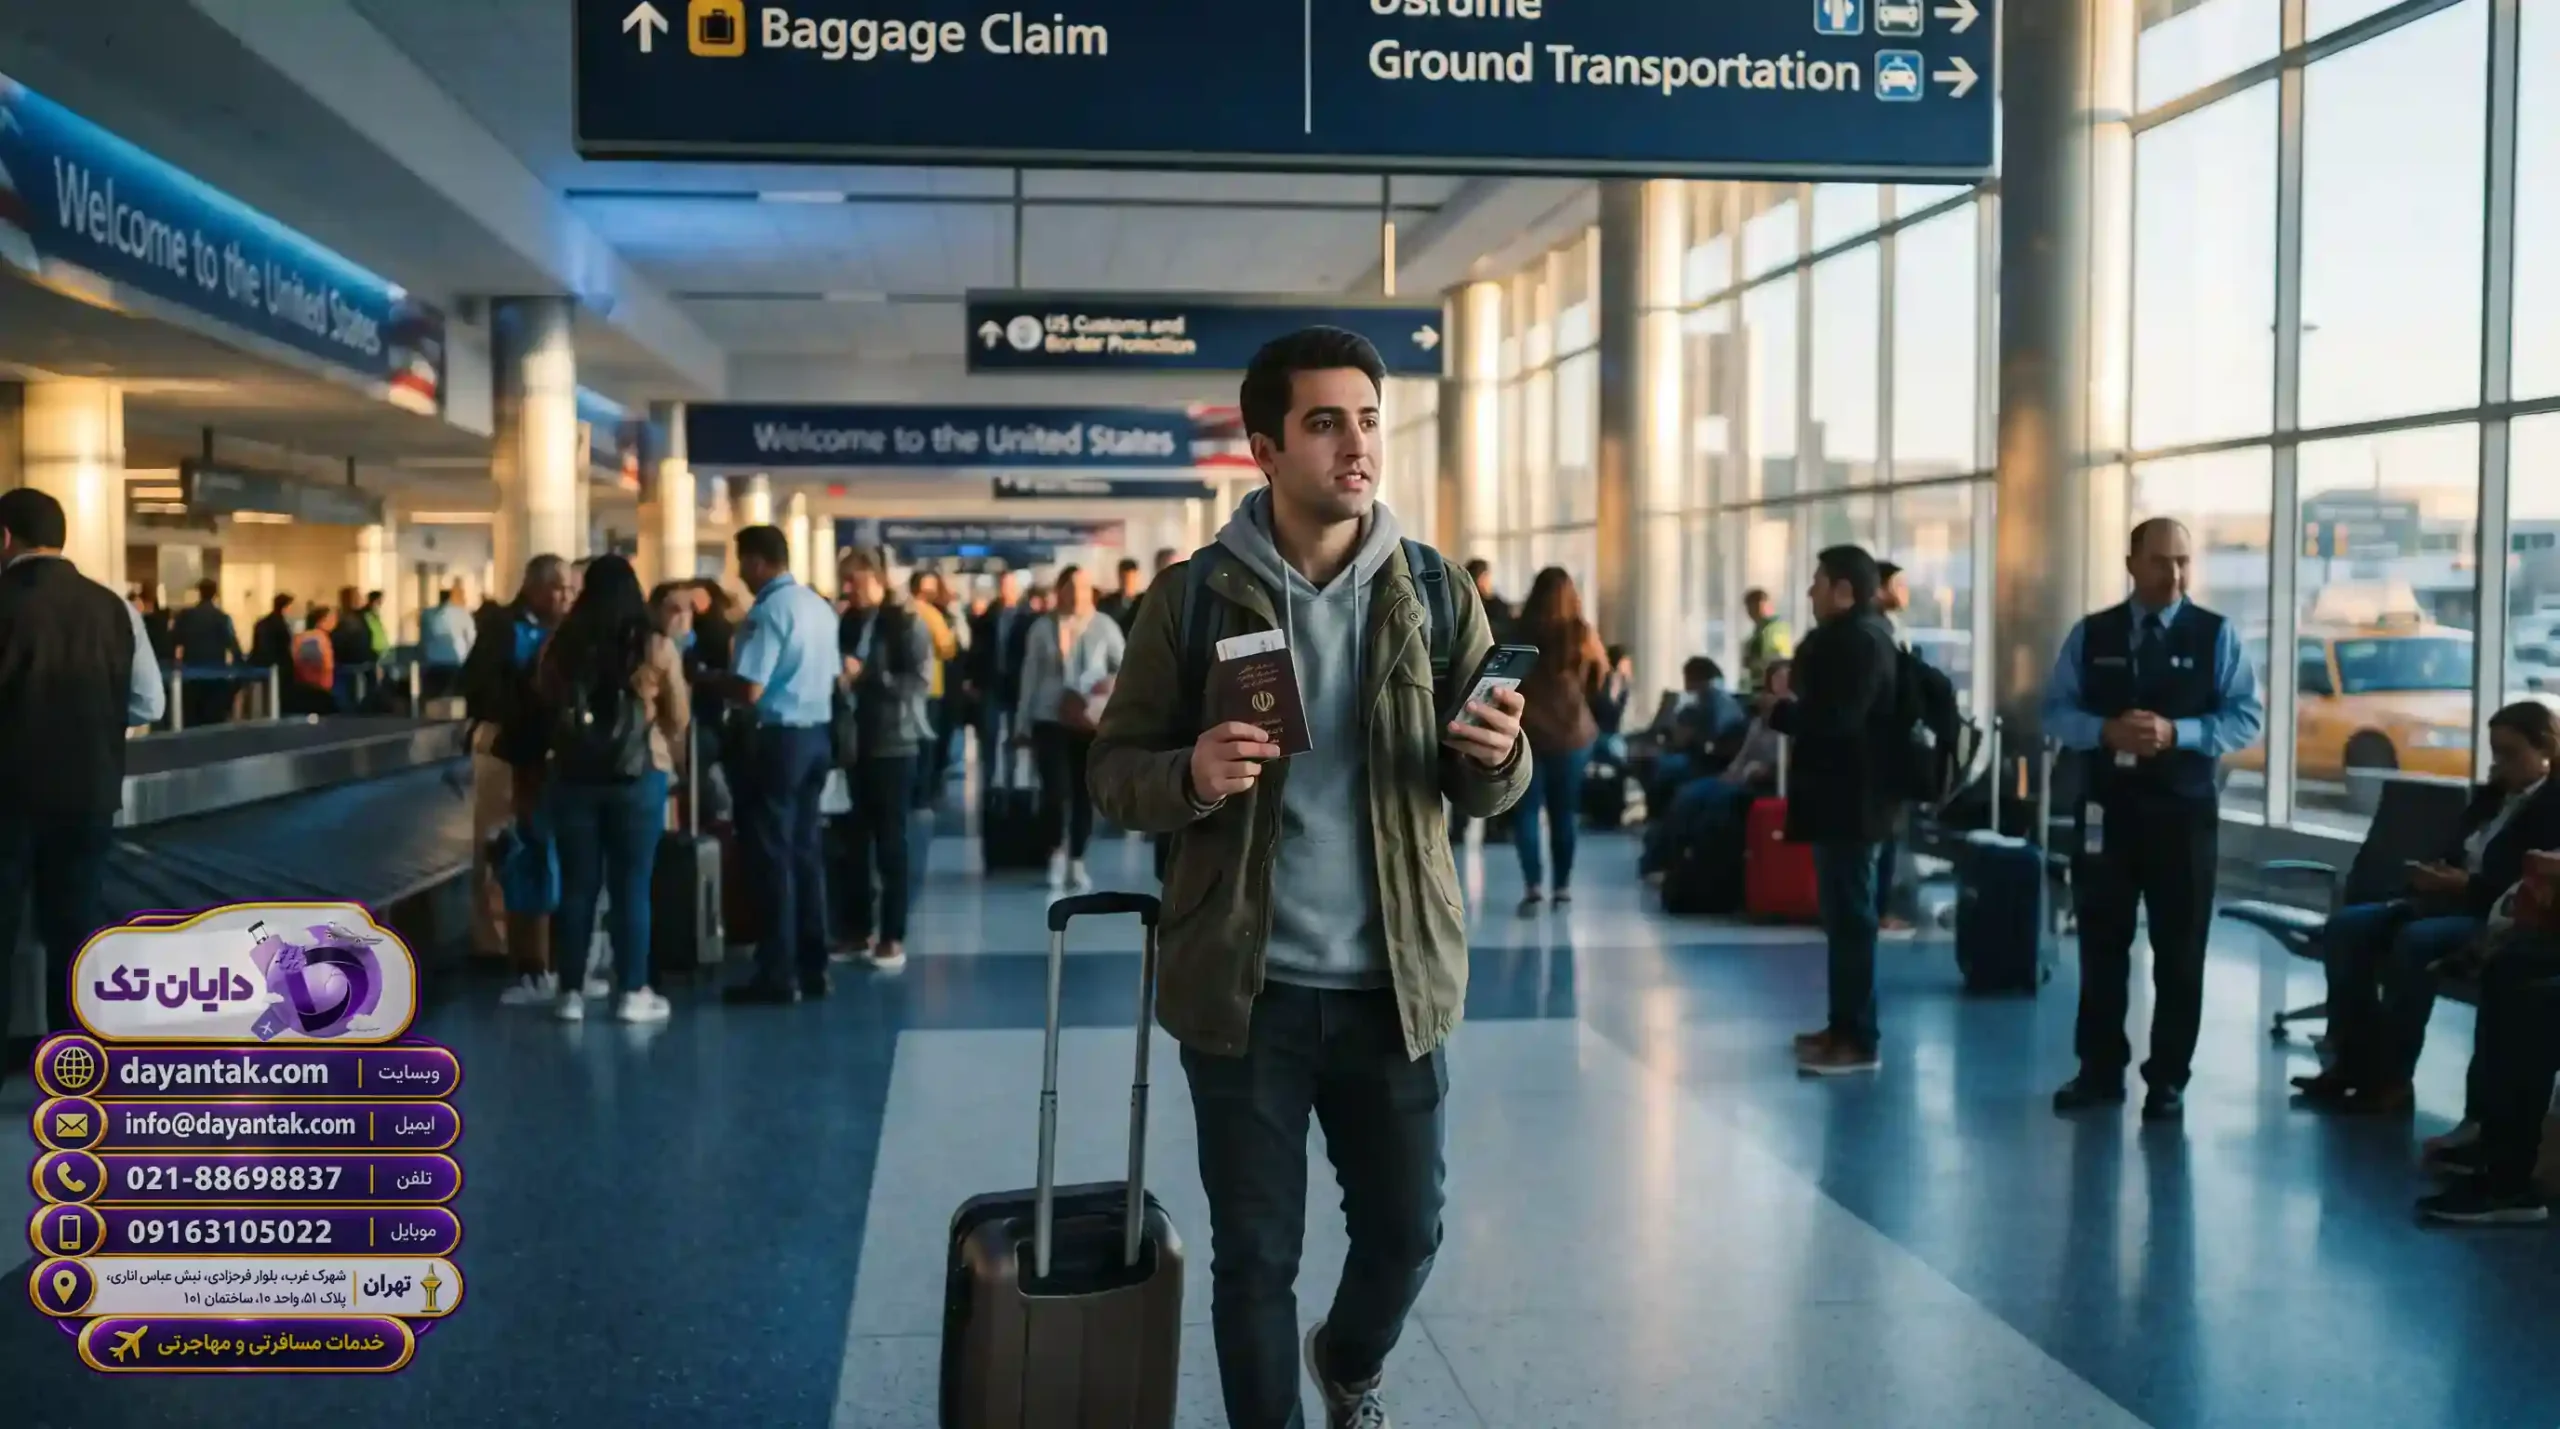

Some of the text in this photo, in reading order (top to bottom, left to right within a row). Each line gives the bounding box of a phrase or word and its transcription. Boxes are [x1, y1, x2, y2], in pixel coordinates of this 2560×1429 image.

[761, 8, 1108, 62] Baggage Claim
[1368, 39, 1861, 95] Ground Transportation
[53, 155, 382, 356] Welcome to the United States
[753, 422, 1176, 457] Welcome to the United States
